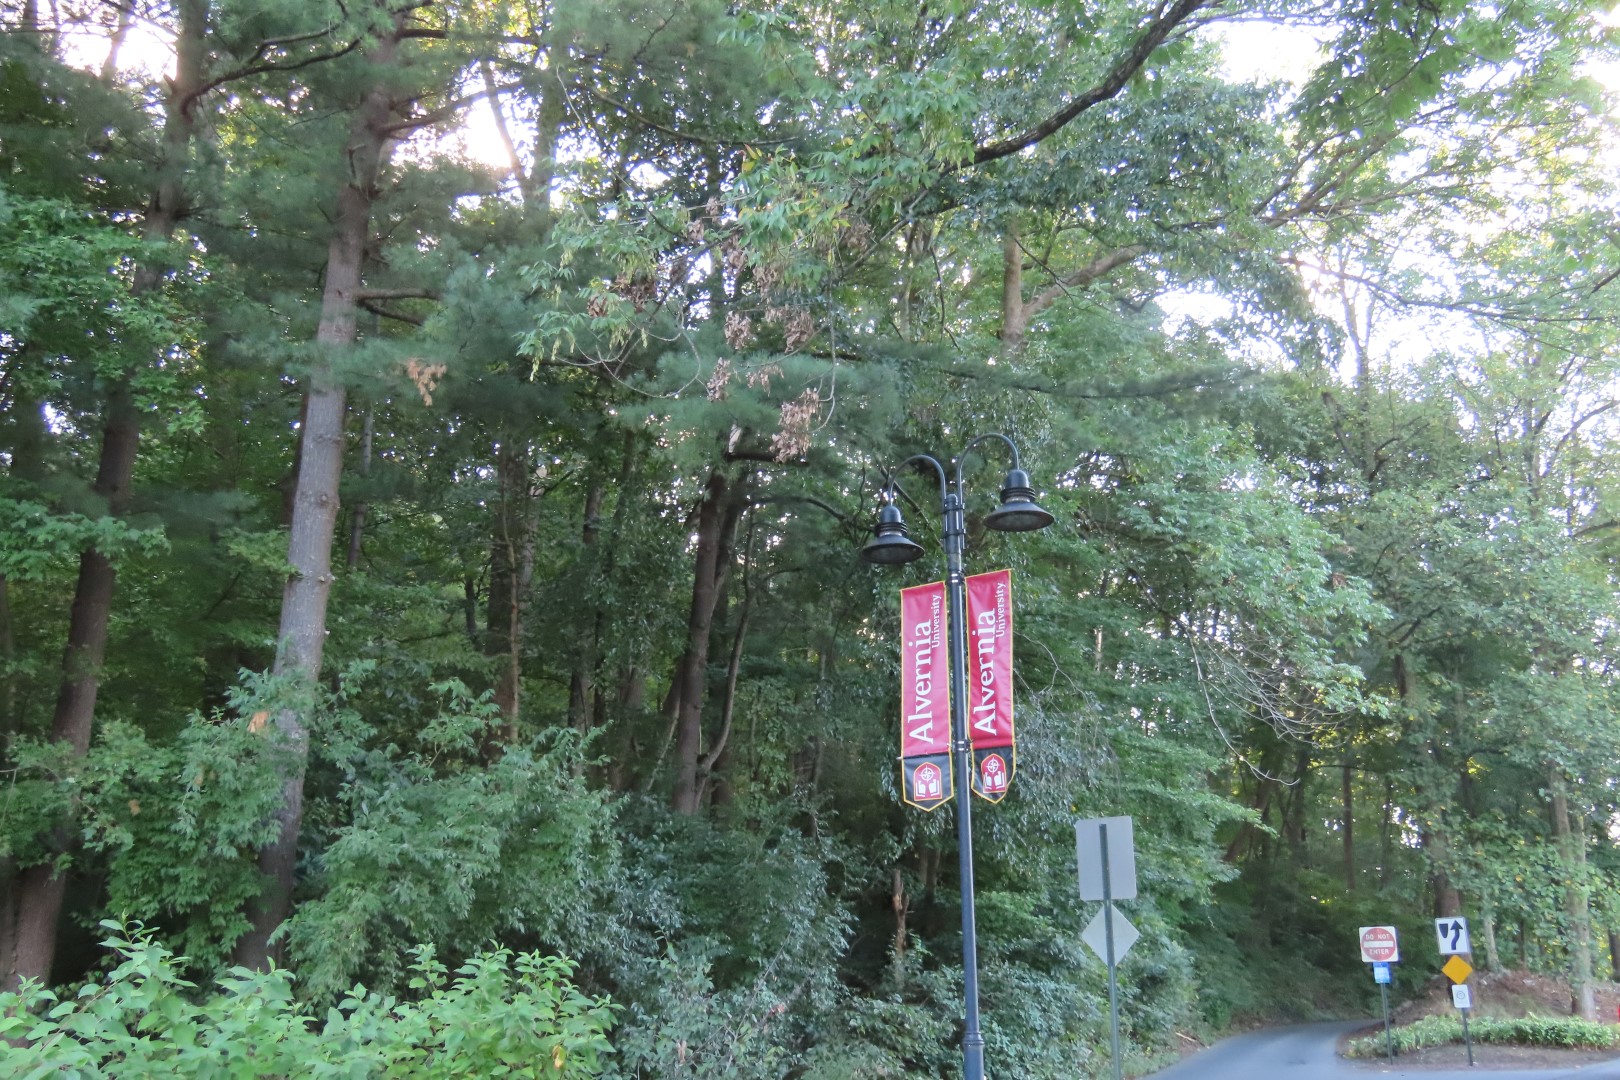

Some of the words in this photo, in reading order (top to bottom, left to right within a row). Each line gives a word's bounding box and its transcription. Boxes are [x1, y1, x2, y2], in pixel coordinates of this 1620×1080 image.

[931, 595, 942, 649] University
[995, 582, 1006, 637] University
[908, 620, 934, 744] Alvernia
[972, 608, 997, 736] Alvernia
